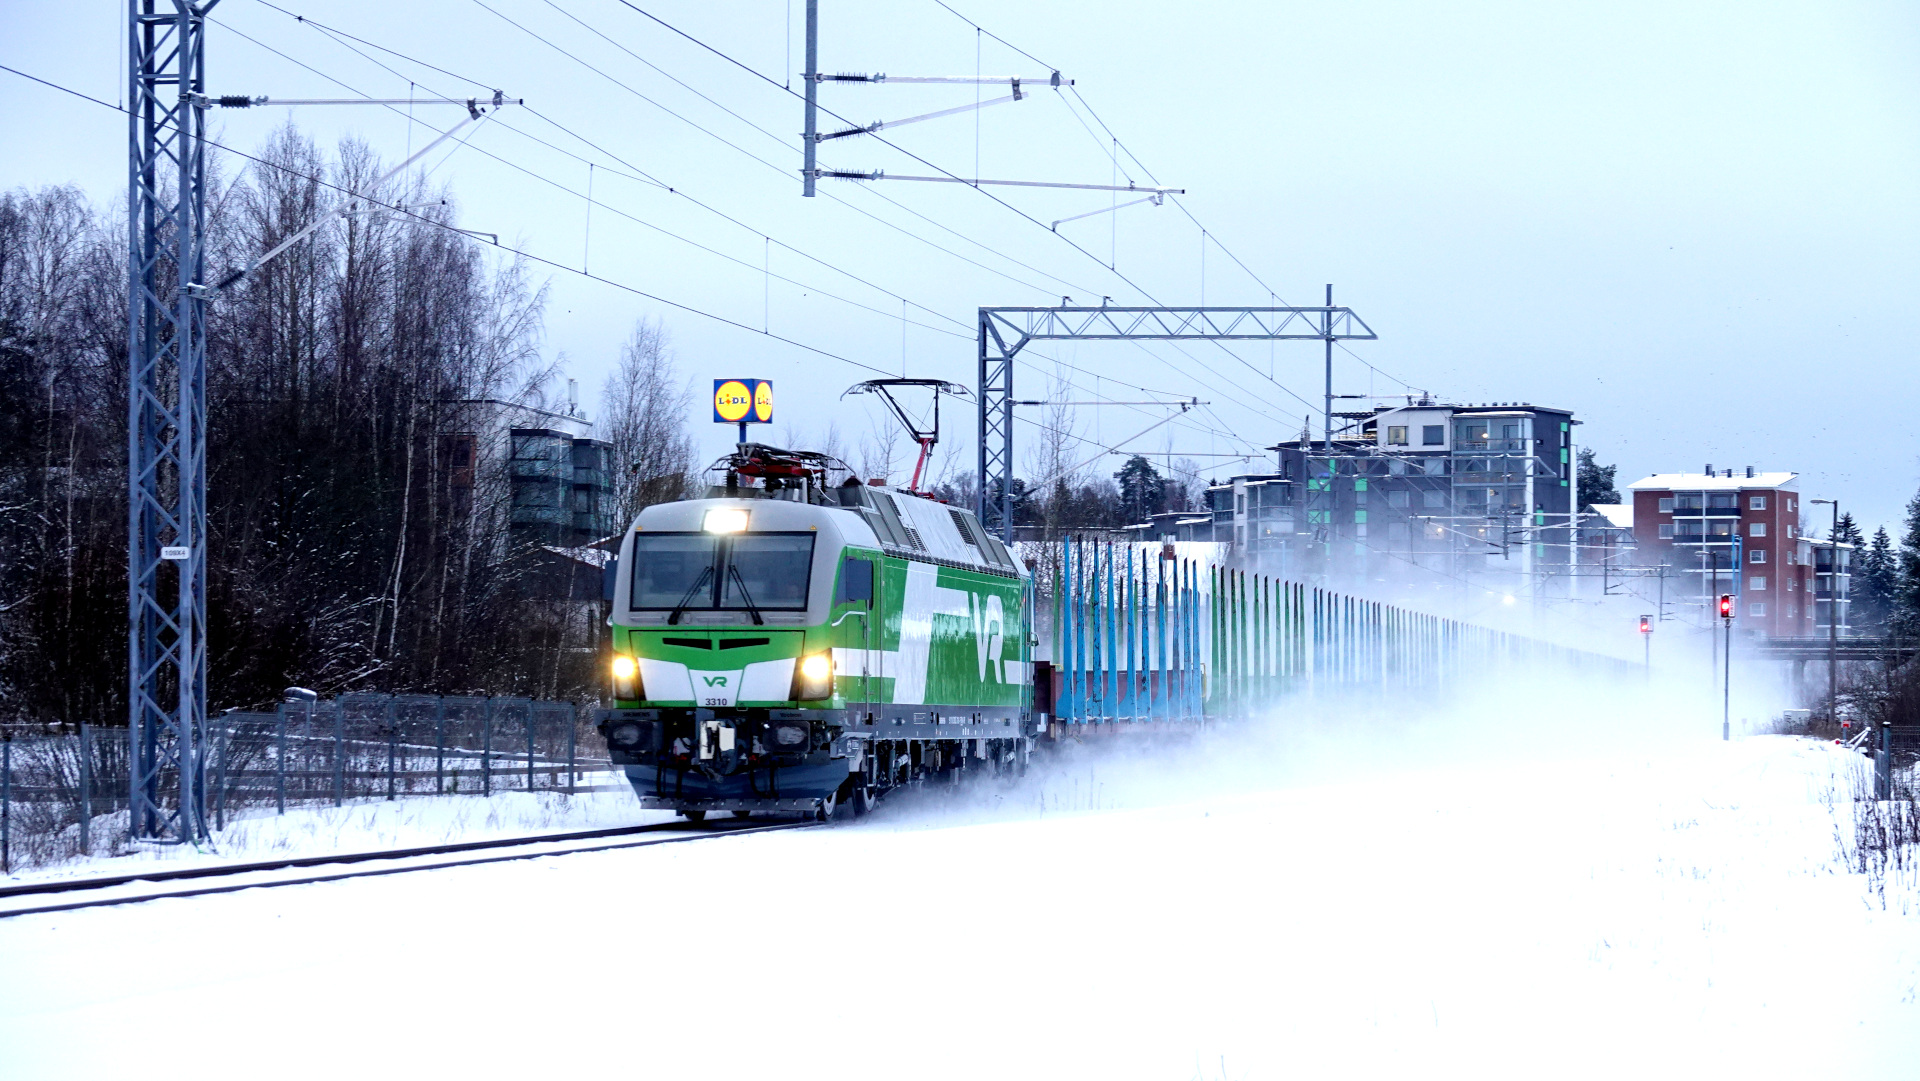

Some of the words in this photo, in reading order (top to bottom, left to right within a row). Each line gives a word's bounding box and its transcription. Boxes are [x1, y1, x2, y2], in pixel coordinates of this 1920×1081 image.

[972, 592, 1004, 684] VR
[703, 676, 727, 688] VR
[705, 697, 727, 706] 3310
